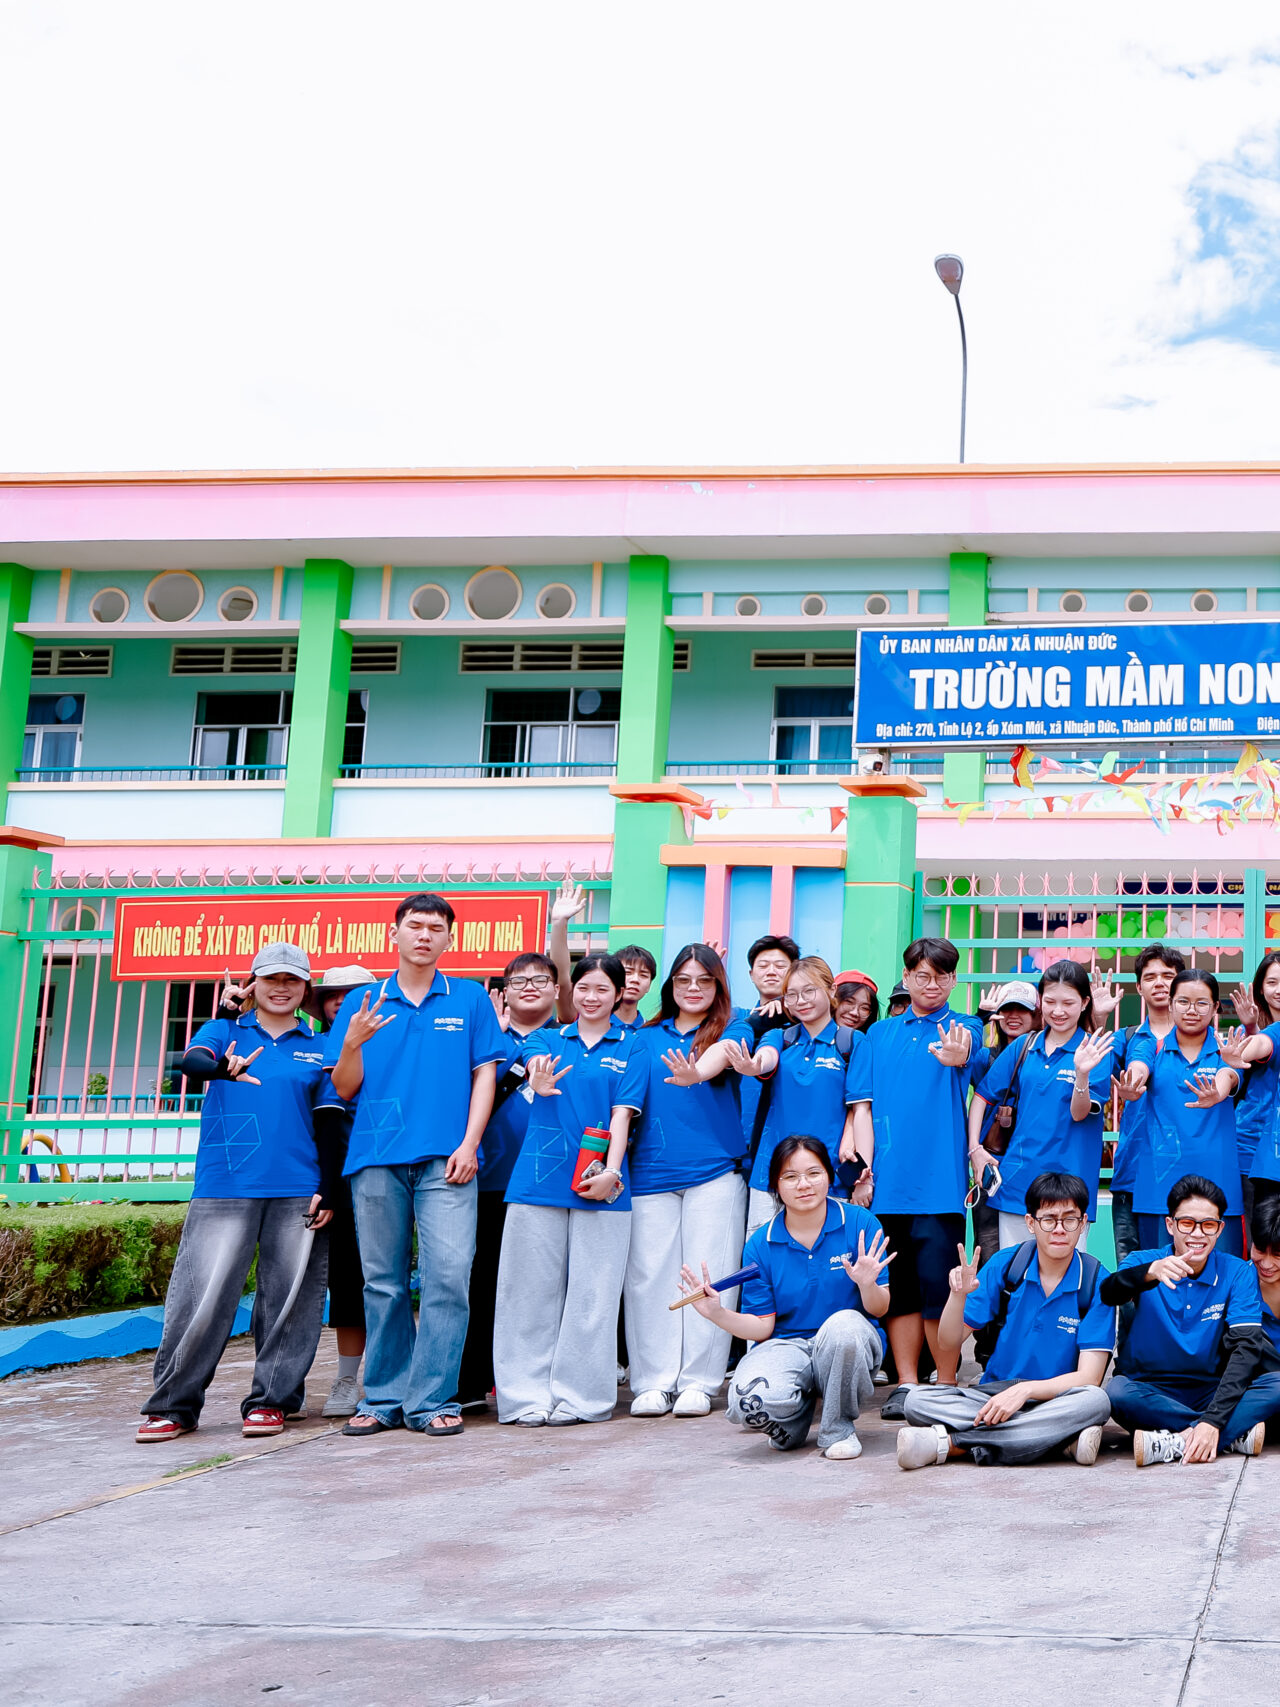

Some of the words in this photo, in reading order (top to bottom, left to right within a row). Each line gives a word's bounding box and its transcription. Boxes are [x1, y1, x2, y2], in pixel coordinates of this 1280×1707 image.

[879, 635, 898, 655] ỦY
[901, 638, 931, 654] BAN
[934, 635, 974, 654] NHÂN
[977, 635, 1007, 653] DÂN
[1011, 633, 1031, 652] XÃ
[1034, 633, 1084, 654] NHUẬN
[1088, 632, 1118, 651] ĐỨC
[909, 660, 1071, 710] TRƯỜNG
[1085, 652, 1185, 707] MẦM
[876, 723, 893, 740] Địa
[895, 721, 913, 737] chỉ:
[915, 723, 936, 738] 270,
[938, 720, 959, 737] Tỉnh
[961, 722, 973, 738] Lộ
[975, 722, 985, 737] 2,
[987, 719, 999, 737] ấp
[1001, 721, 1023, 735] Xóm
[1025, 720, 1047, 736] Mới,
[1049, 721, 1062, 735] xã
[1064, 719, 1096, 737] Nhuận
[1097, 719, 1119, 735] Đức,
[1122, 718, 1151, 733] Thành
[1153, 716, 1173, 734] phố
[1174, 716, 1188, 732] Hồ
[1190, 717, 1207, 732] Chí
[1209, 717, 1235, 732] Minh
[1257, 717, 1280, 734] Điện
[133, 920, 181, 957] KHÔNG
[184, 913, 205, 956] ĐỂ
[204, 915, 234, 956] XẢY
[236, 924, 254, 956] RA
[300, 911, 321, 957] NỔ,
[326, 917, 342, 954] LÀ
[346, 922, 387, 960] HẠNH
[462, 920, 492, 959] MỌI
[493, 914, 523, 952] NHÀ
